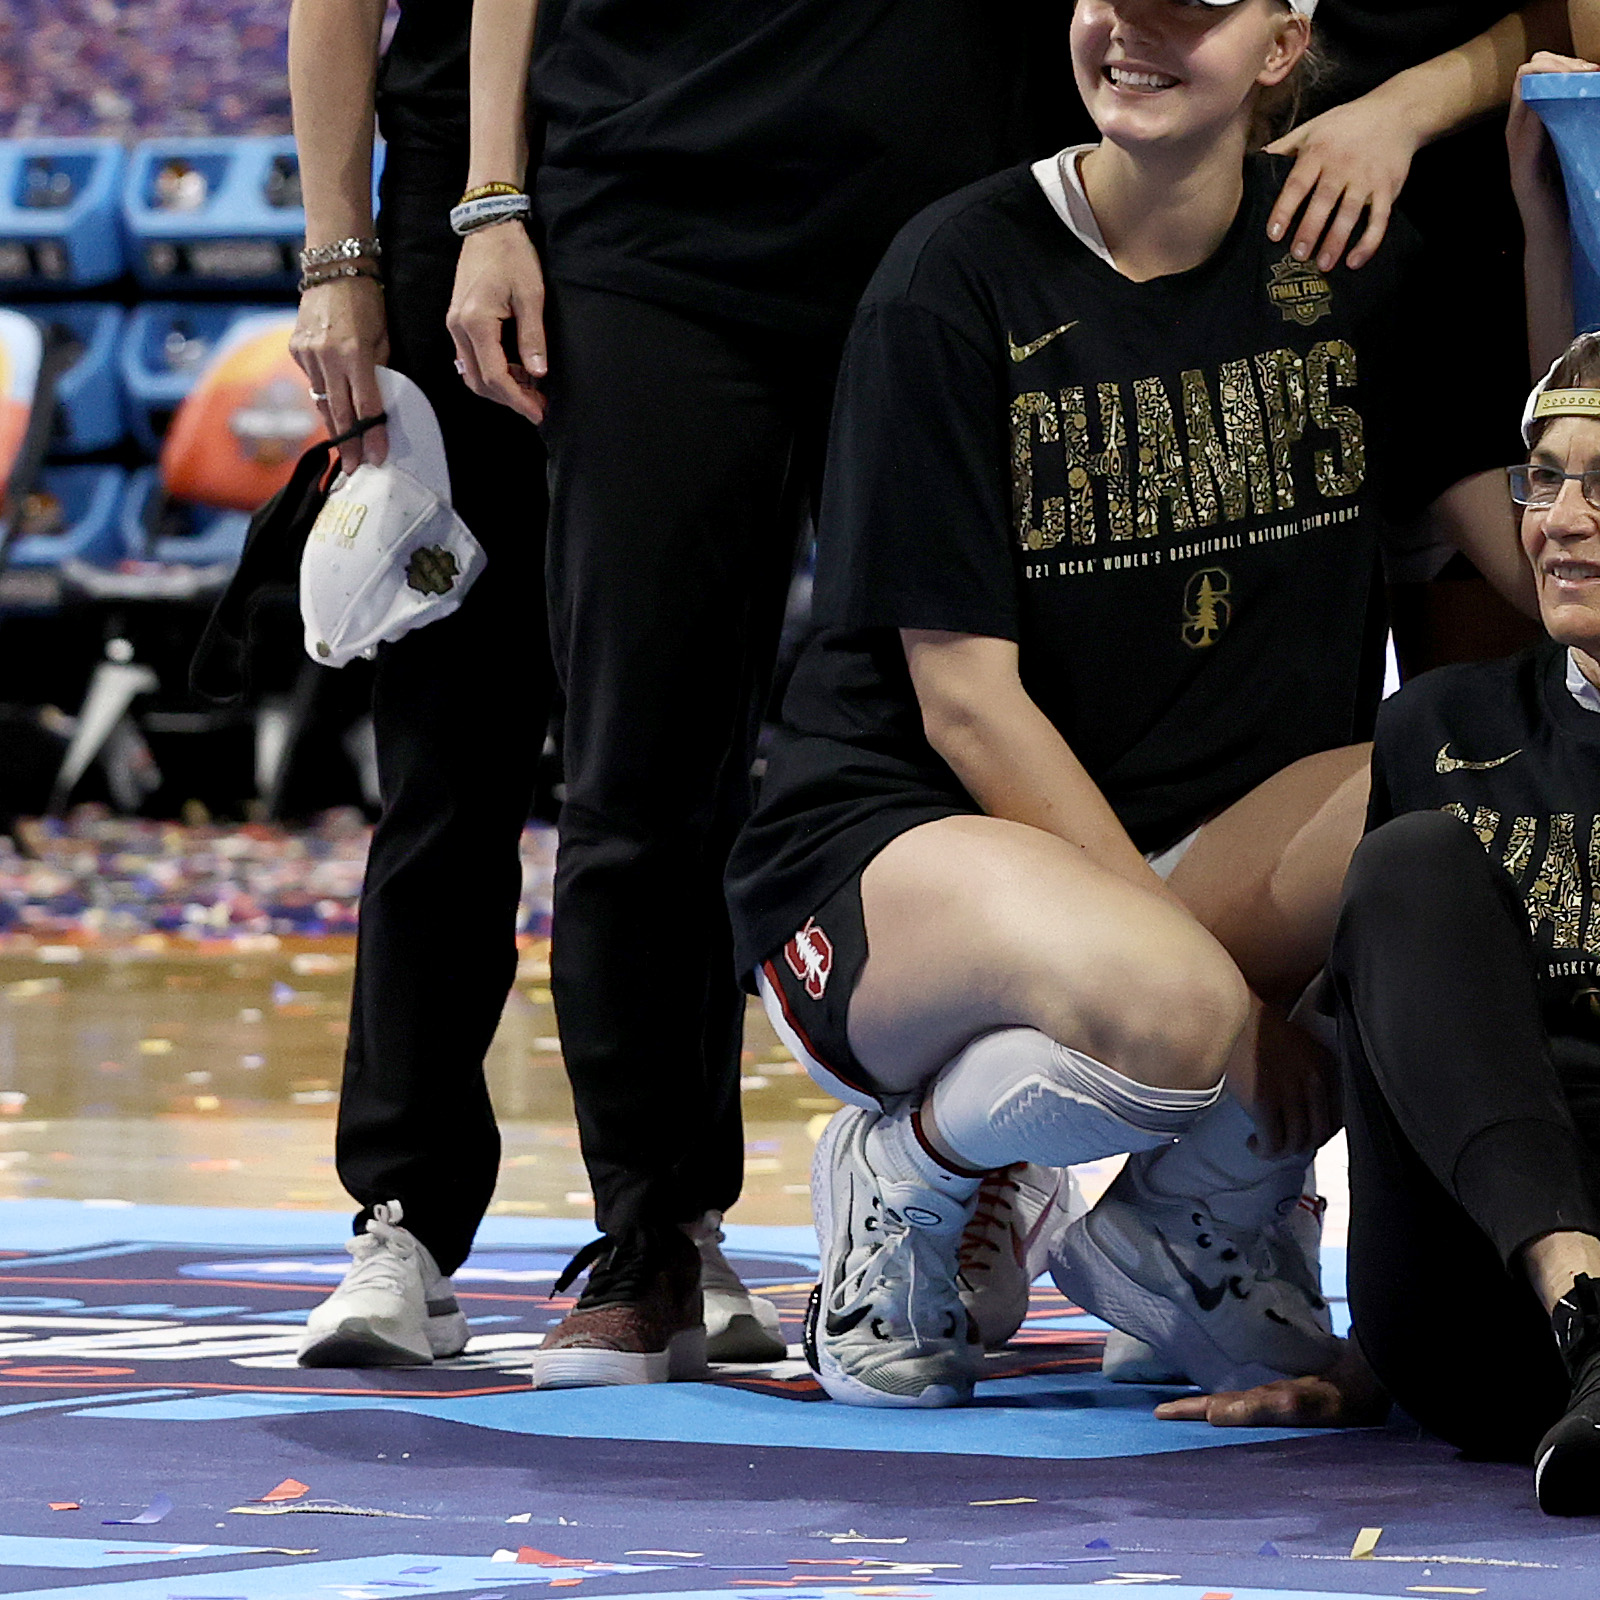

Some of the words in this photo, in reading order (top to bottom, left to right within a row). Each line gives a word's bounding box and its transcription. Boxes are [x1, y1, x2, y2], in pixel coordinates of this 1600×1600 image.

[1009, 340, 1366, 550] CHAMPS
[1026, 564, 1049, 579] 021
[1103, 551, 1161, 571] WOMEN'S
